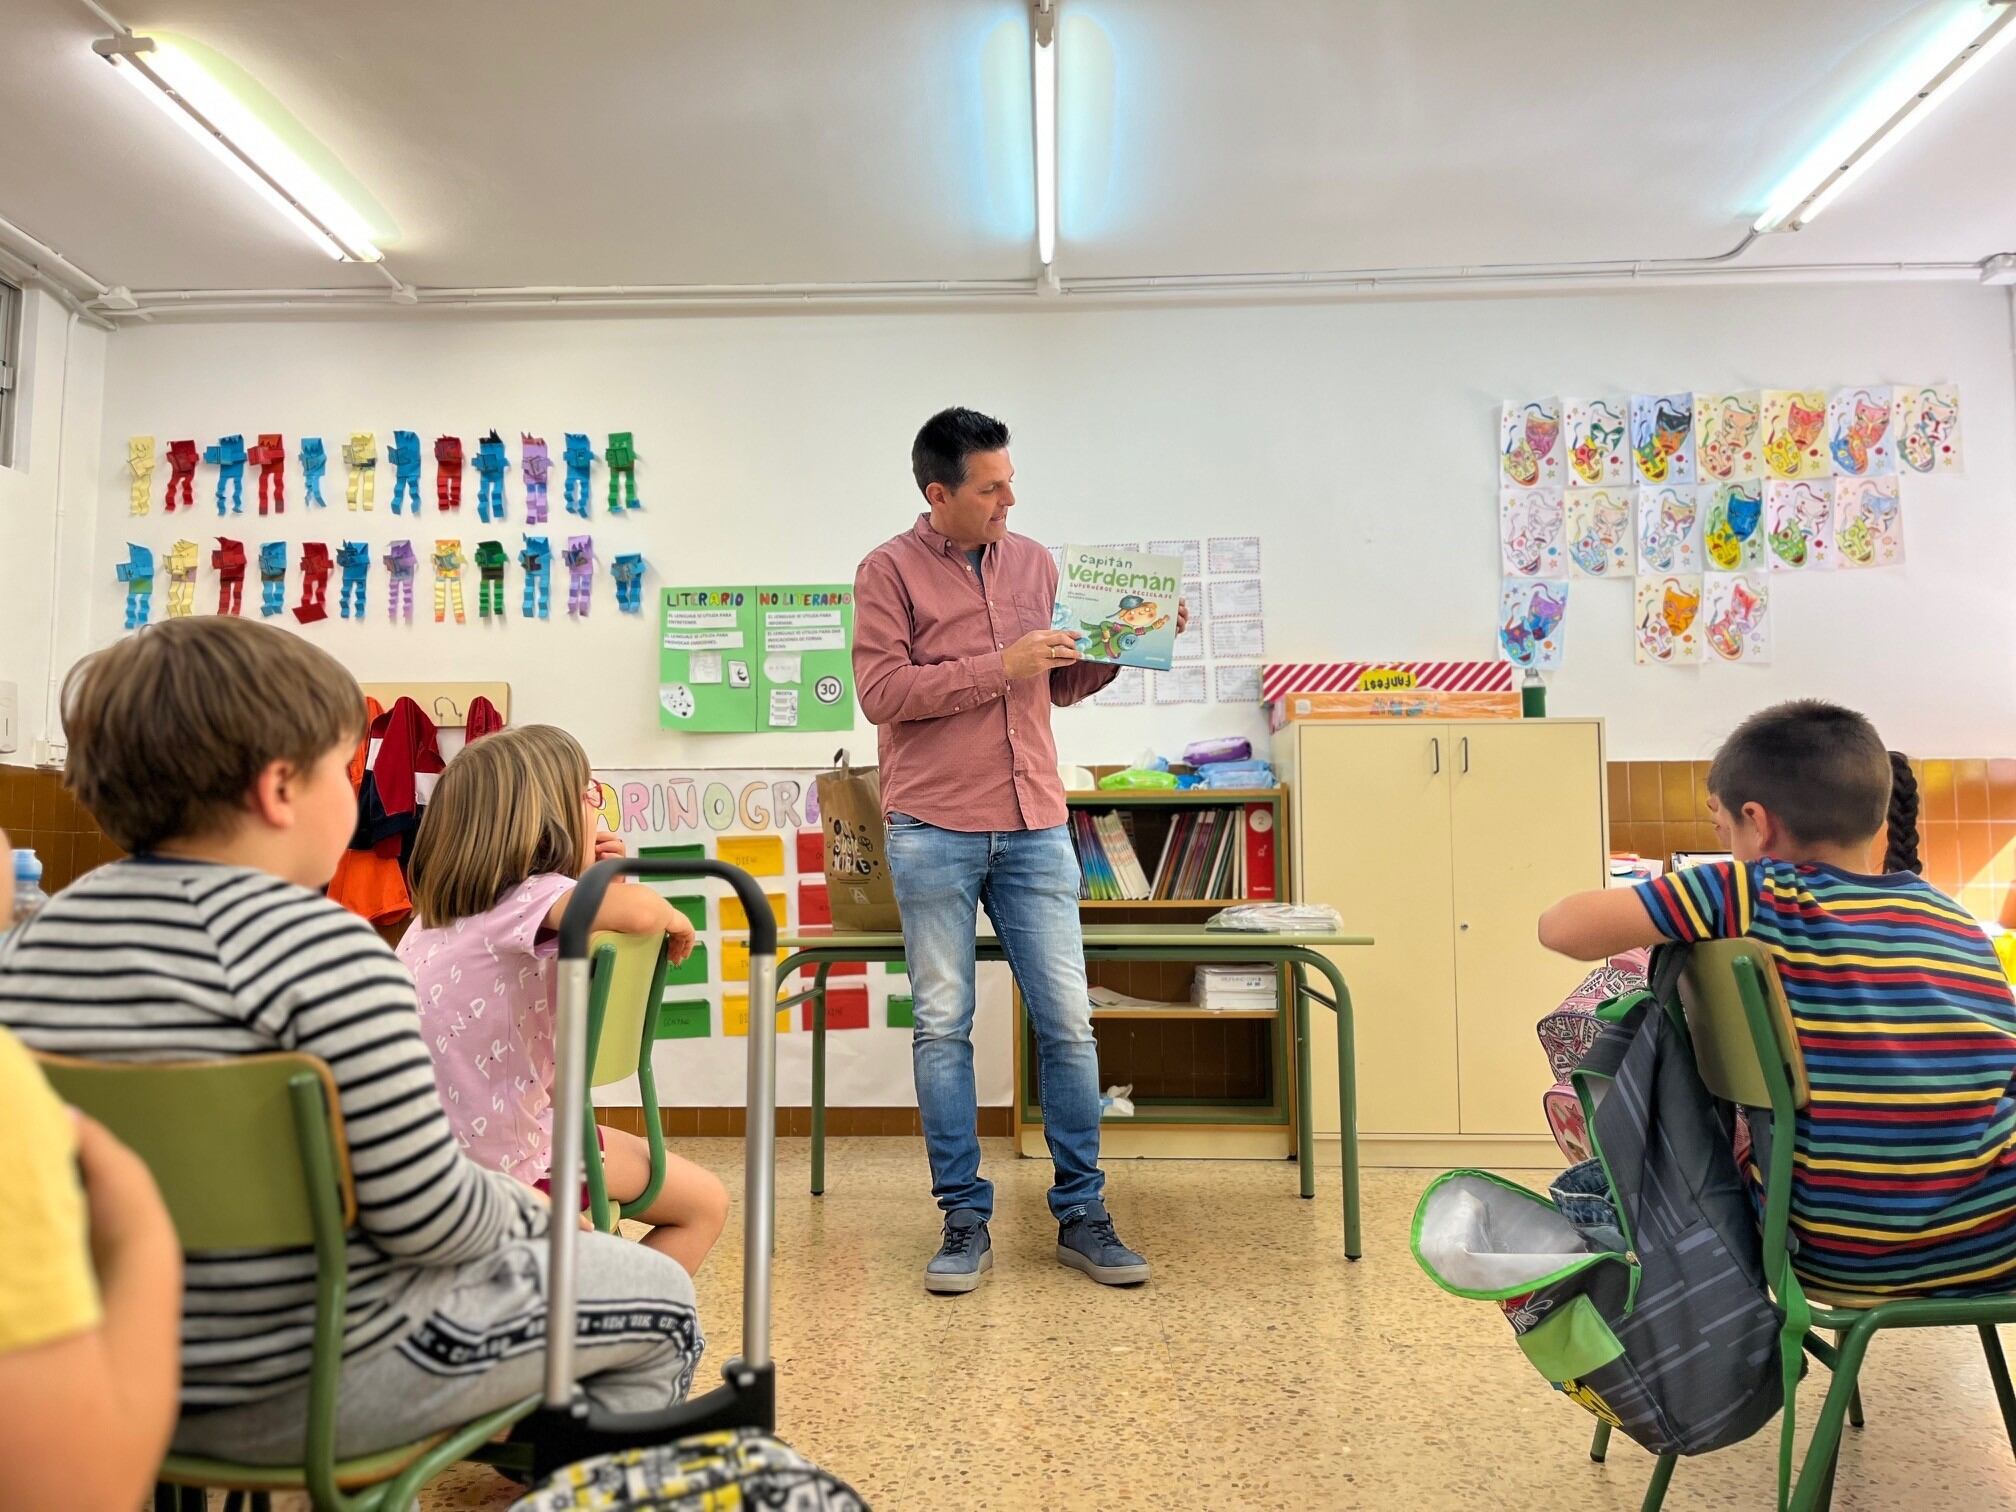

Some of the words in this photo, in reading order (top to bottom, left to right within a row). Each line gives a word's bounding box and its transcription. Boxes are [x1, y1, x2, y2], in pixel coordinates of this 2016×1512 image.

[1068, 563, 1175, 593] Verdemán
[666, 592, 744, 607] LITERARIO
[759, 592, 778, 607] NO
[782, 591, 852, 606] LITERARIO
[820, 683, 837, 696] 30
